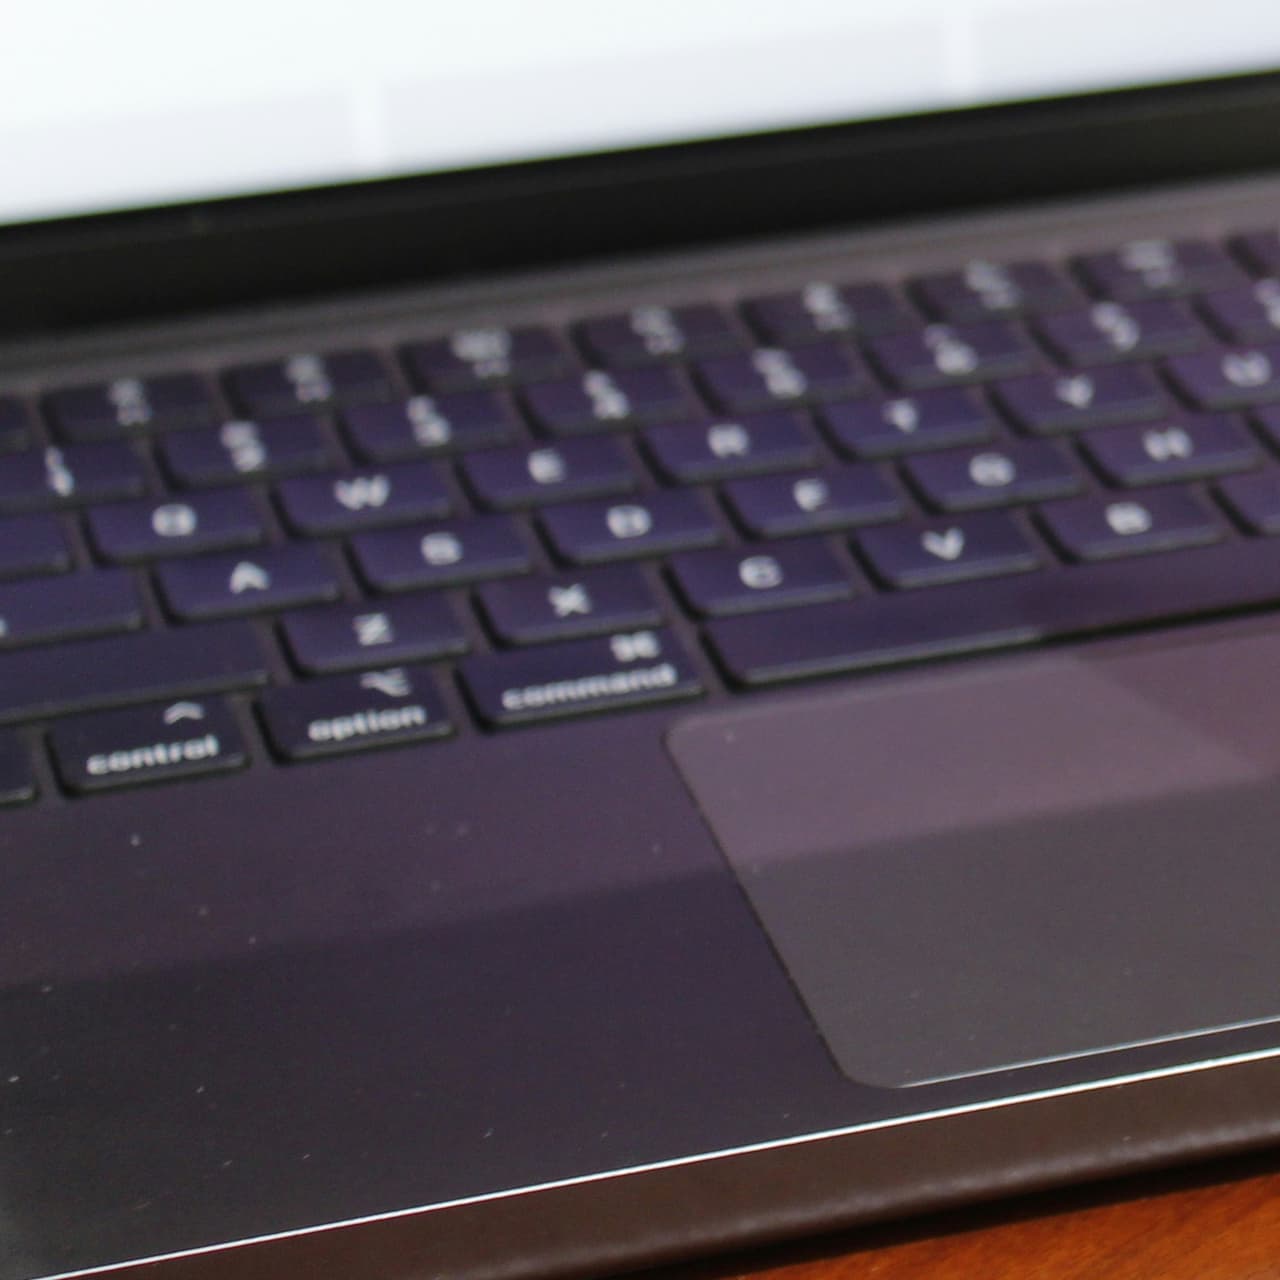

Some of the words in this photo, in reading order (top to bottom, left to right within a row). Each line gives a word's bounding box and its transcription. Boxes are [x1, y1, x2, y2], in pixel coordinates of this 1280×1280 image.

[502, 663, 677, 711] command
[308, 705, 427, 742] option
[86, 734, 220, 776] control
